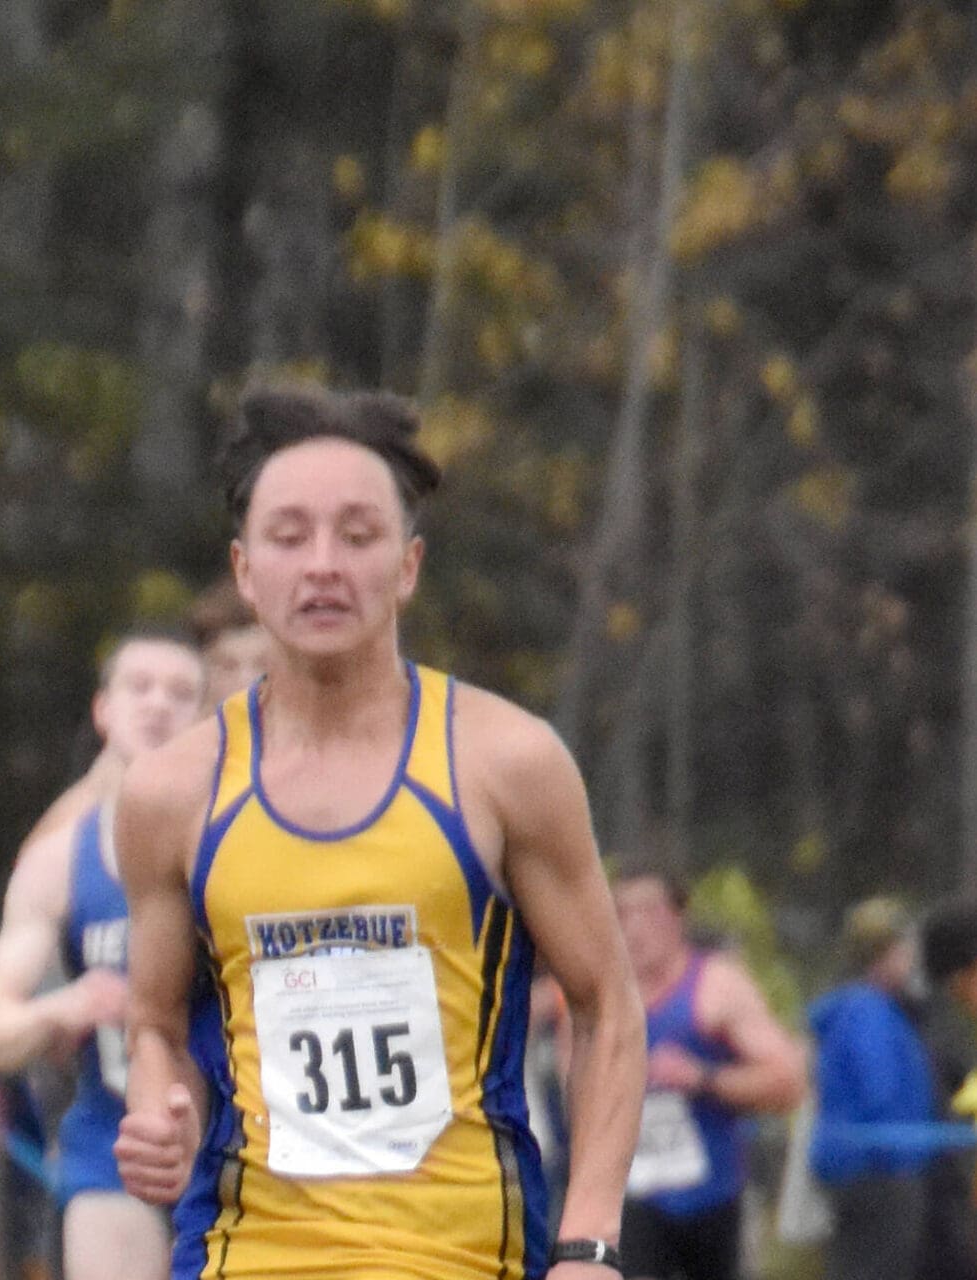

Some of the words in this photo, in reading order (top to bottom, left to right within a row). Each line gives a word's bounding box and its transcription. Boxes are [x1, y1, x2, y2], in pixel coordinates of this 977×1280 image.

[257, 914, 408, 957] KOTZEBUE
[284, 970, 317, 988] GCI
[289, 1021, 417, 1114] 315
